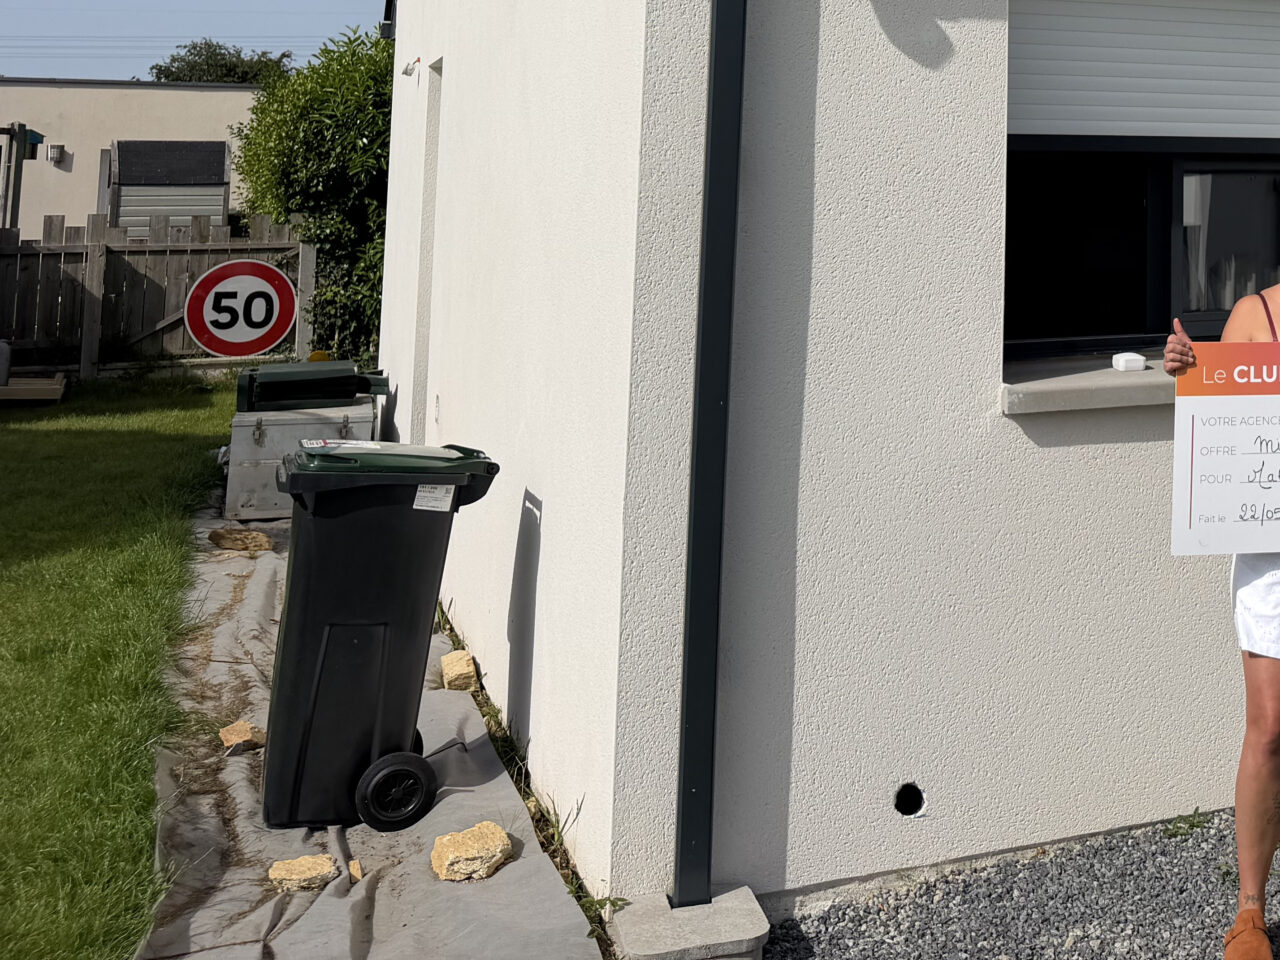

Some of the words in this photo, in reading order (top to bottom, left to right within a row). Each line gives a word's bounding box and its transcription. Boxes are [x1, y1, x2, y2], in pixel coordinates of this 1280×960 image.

[209, 290, 275, 330] 50
[1202, 365, 1227, 384] Le
[1200, 416, 1237, 427] VOTRE
[1200, 446, 1237, 456] OFFRE
[1200, 474, 1232, 484] POUR
